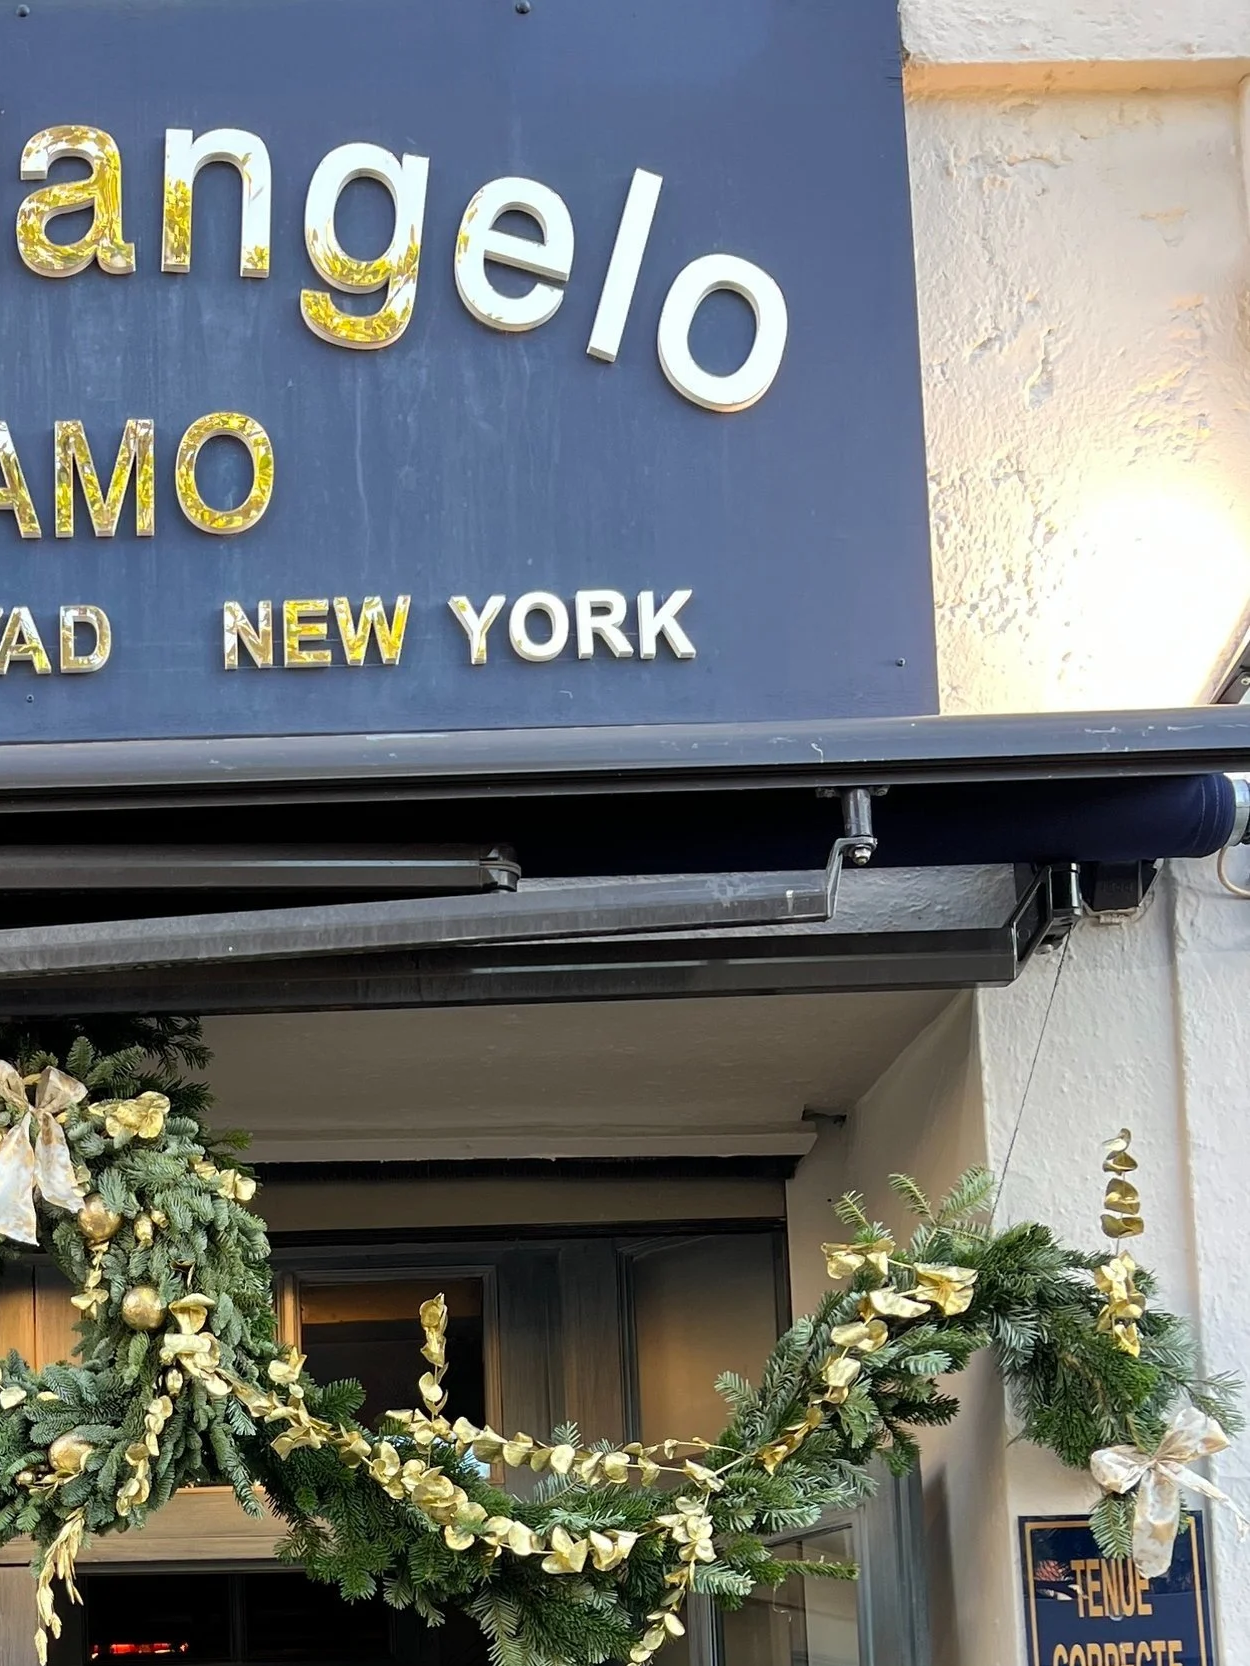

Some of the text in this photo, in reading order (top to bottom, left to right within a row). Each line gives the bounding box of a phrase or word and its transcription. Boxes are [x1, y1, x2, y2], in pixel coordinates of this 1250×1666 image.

[221, 595, 410, 671] NEW
[449, 589, 696, 666] YORK
[1071, 1559, 1153, 1618] TENUE
